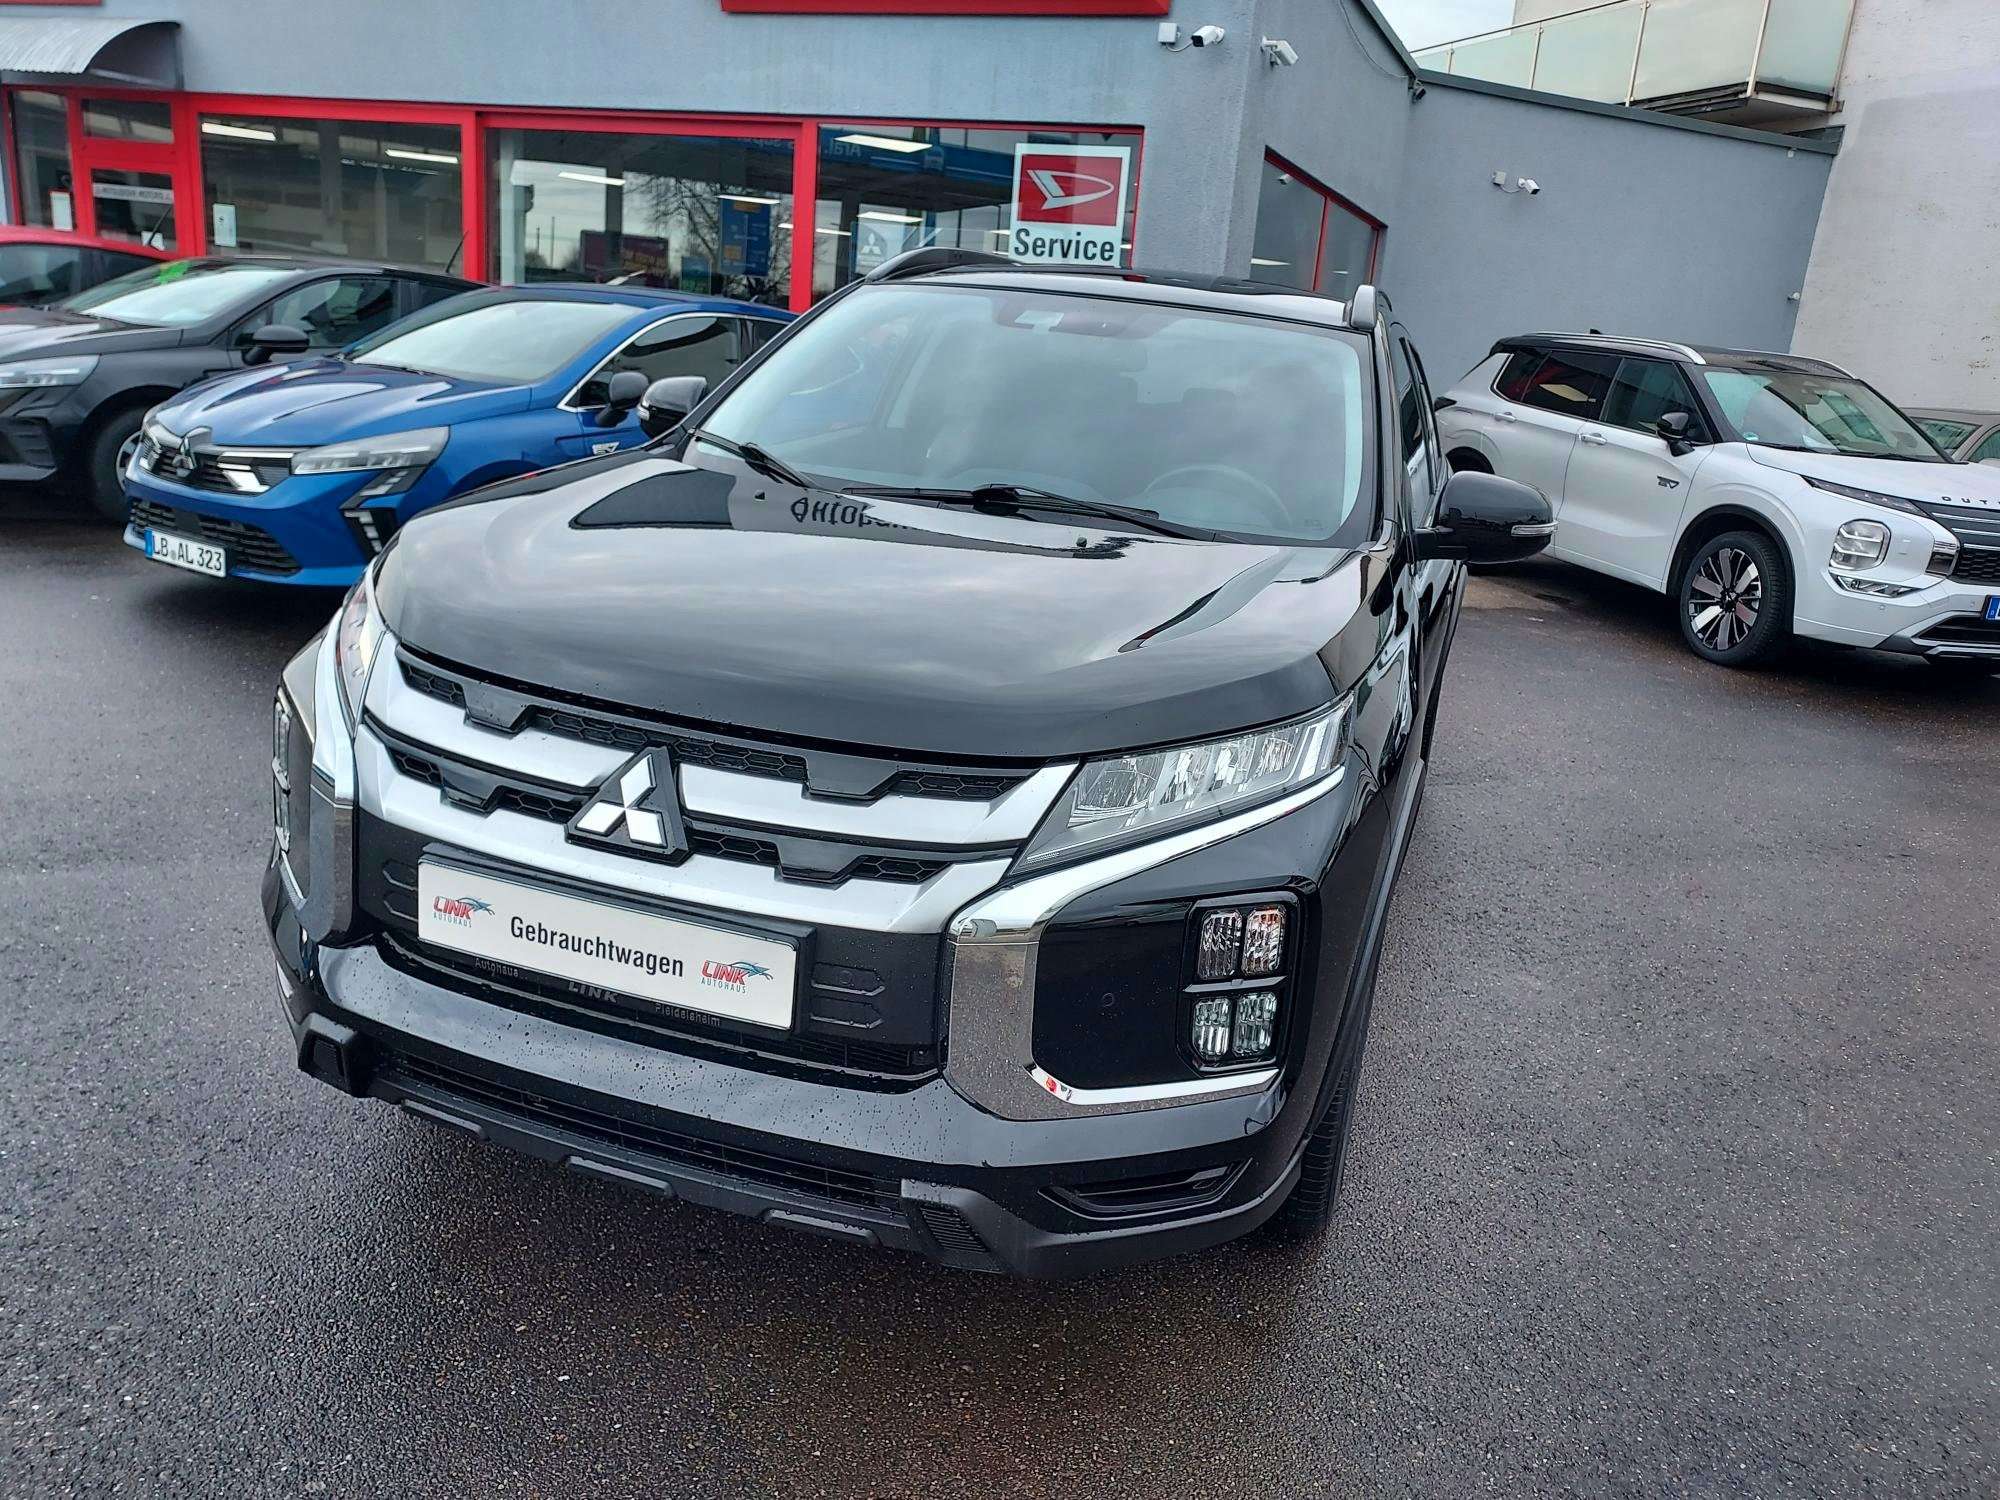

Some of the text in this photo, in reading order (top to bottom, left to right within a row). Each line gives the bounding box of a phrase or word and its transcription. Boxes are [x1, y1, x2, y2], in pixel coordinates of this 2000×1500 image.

[1014, 228, 1115, 262] Service
[152, 535, 222, 571] LB AL 323
[433, 896, 472, 920] LINK
[433, 912, 472, 928] AUTOHAUS
[510, 916, 684, 977] Gebrauchtwagen
[701, 960, 746, 985] LINK
[568, 981, 617, 1003] LINK
[701, 977, 746, 993] AUTOHAUS
